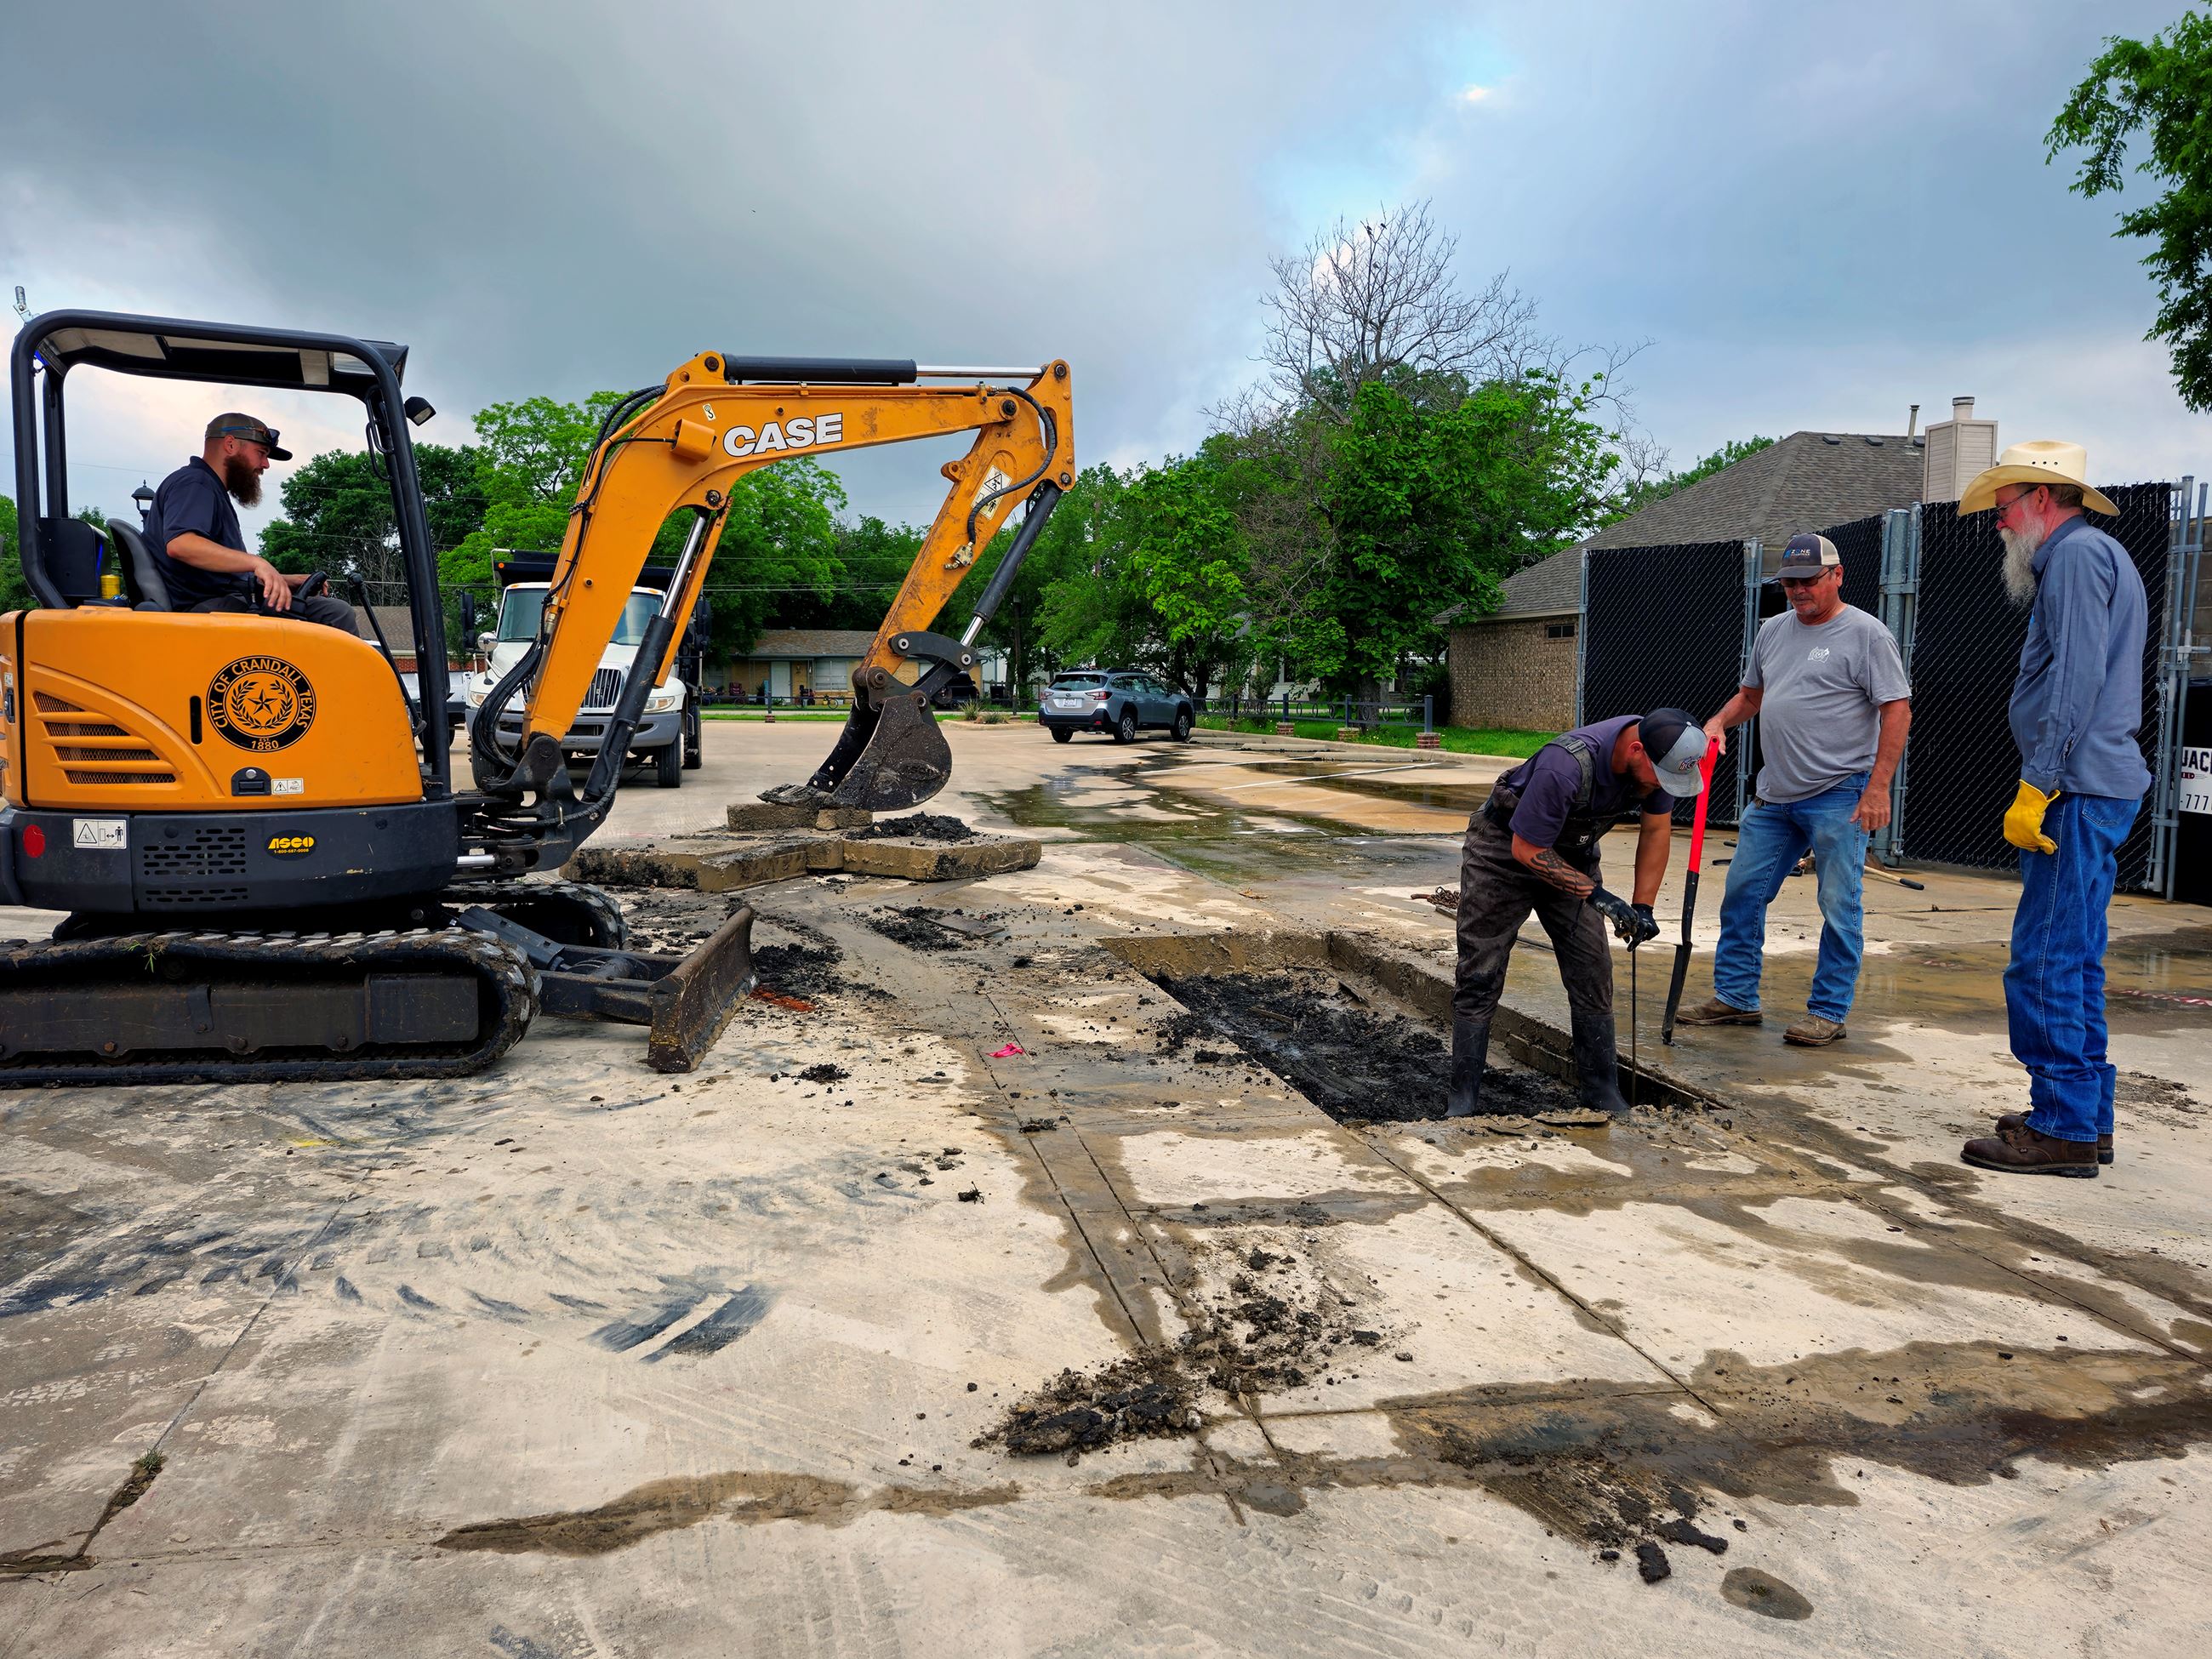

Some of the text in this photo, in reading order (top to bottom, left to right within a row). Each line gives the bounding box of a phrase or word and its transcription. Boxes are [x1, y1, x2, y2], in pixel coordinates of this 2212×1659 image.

[723, 413, 843, 457] CASE
[211, 658, 313, 728] CITY OF CRANDALL TEXAS
[251, 740, 279, 750] 1880
[2181, 750, 2212, 774] JAC
[268, 837, 314, 849] ASCO
